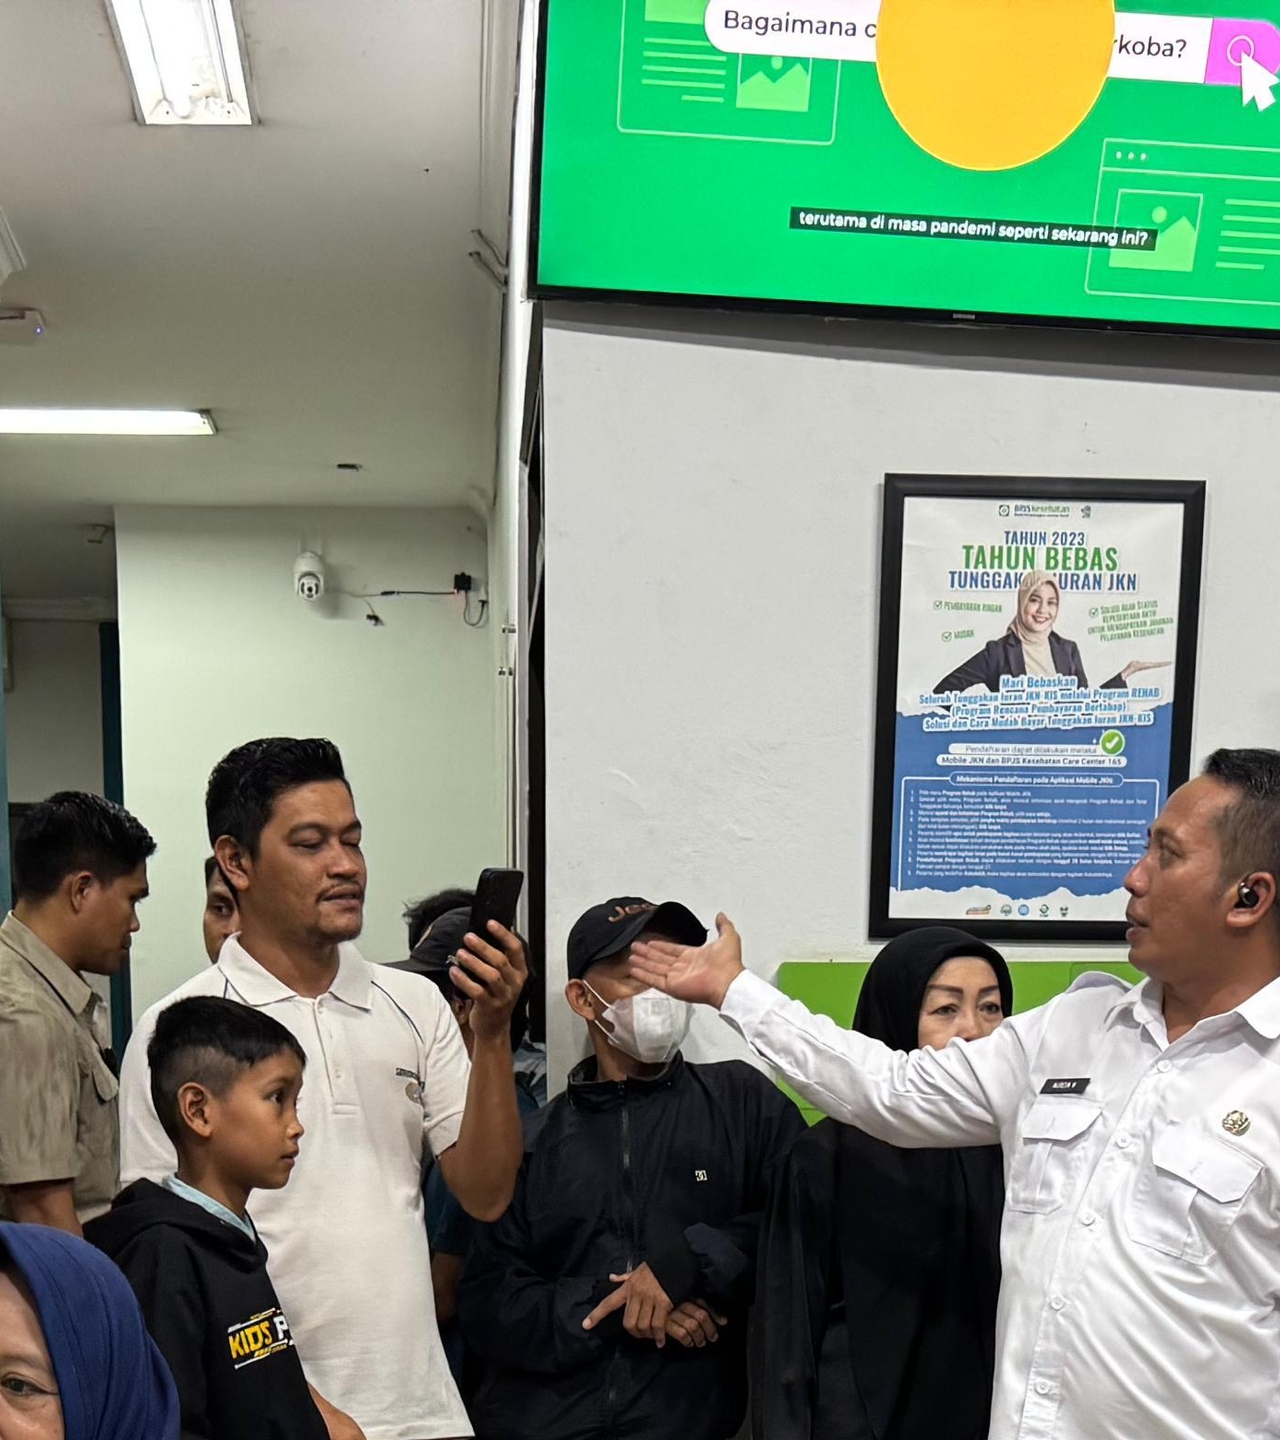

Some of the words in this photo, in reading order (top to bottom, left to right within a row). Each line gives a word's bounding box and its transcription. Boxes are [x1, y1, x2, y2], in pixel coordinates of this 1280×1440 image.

[724, 10, 857, 38] Bagaimana
[799, 211, 866, 229] terutama
[870, 214, 884, 229] di
[888, 218, 927, 232] masa
[931, 219, 996, 238] pandemi
[998, 222, 1048, 240] seperti
[1051, 225, 1119, 247] sekarang
[1121, 230, 1148, 246] ini?
[1004, 530, 1047, 546] TAHUN
[1052, 532, 1085, 546] 2023
[962, 545, 1036, 570] TAHUN
[1045, 546, 1118, 571] BEBAS
[948, 571, 1023, 590] TUNGGAK
[1054, 573, 1102, 591] URAN
[1108, 573, 1137, 591] JKN
[1001, 678, 1024, 688] Mari
[1027, 677, 1076, 688] Bebaskan
[227, 1320, 273, 1359] KIDS
